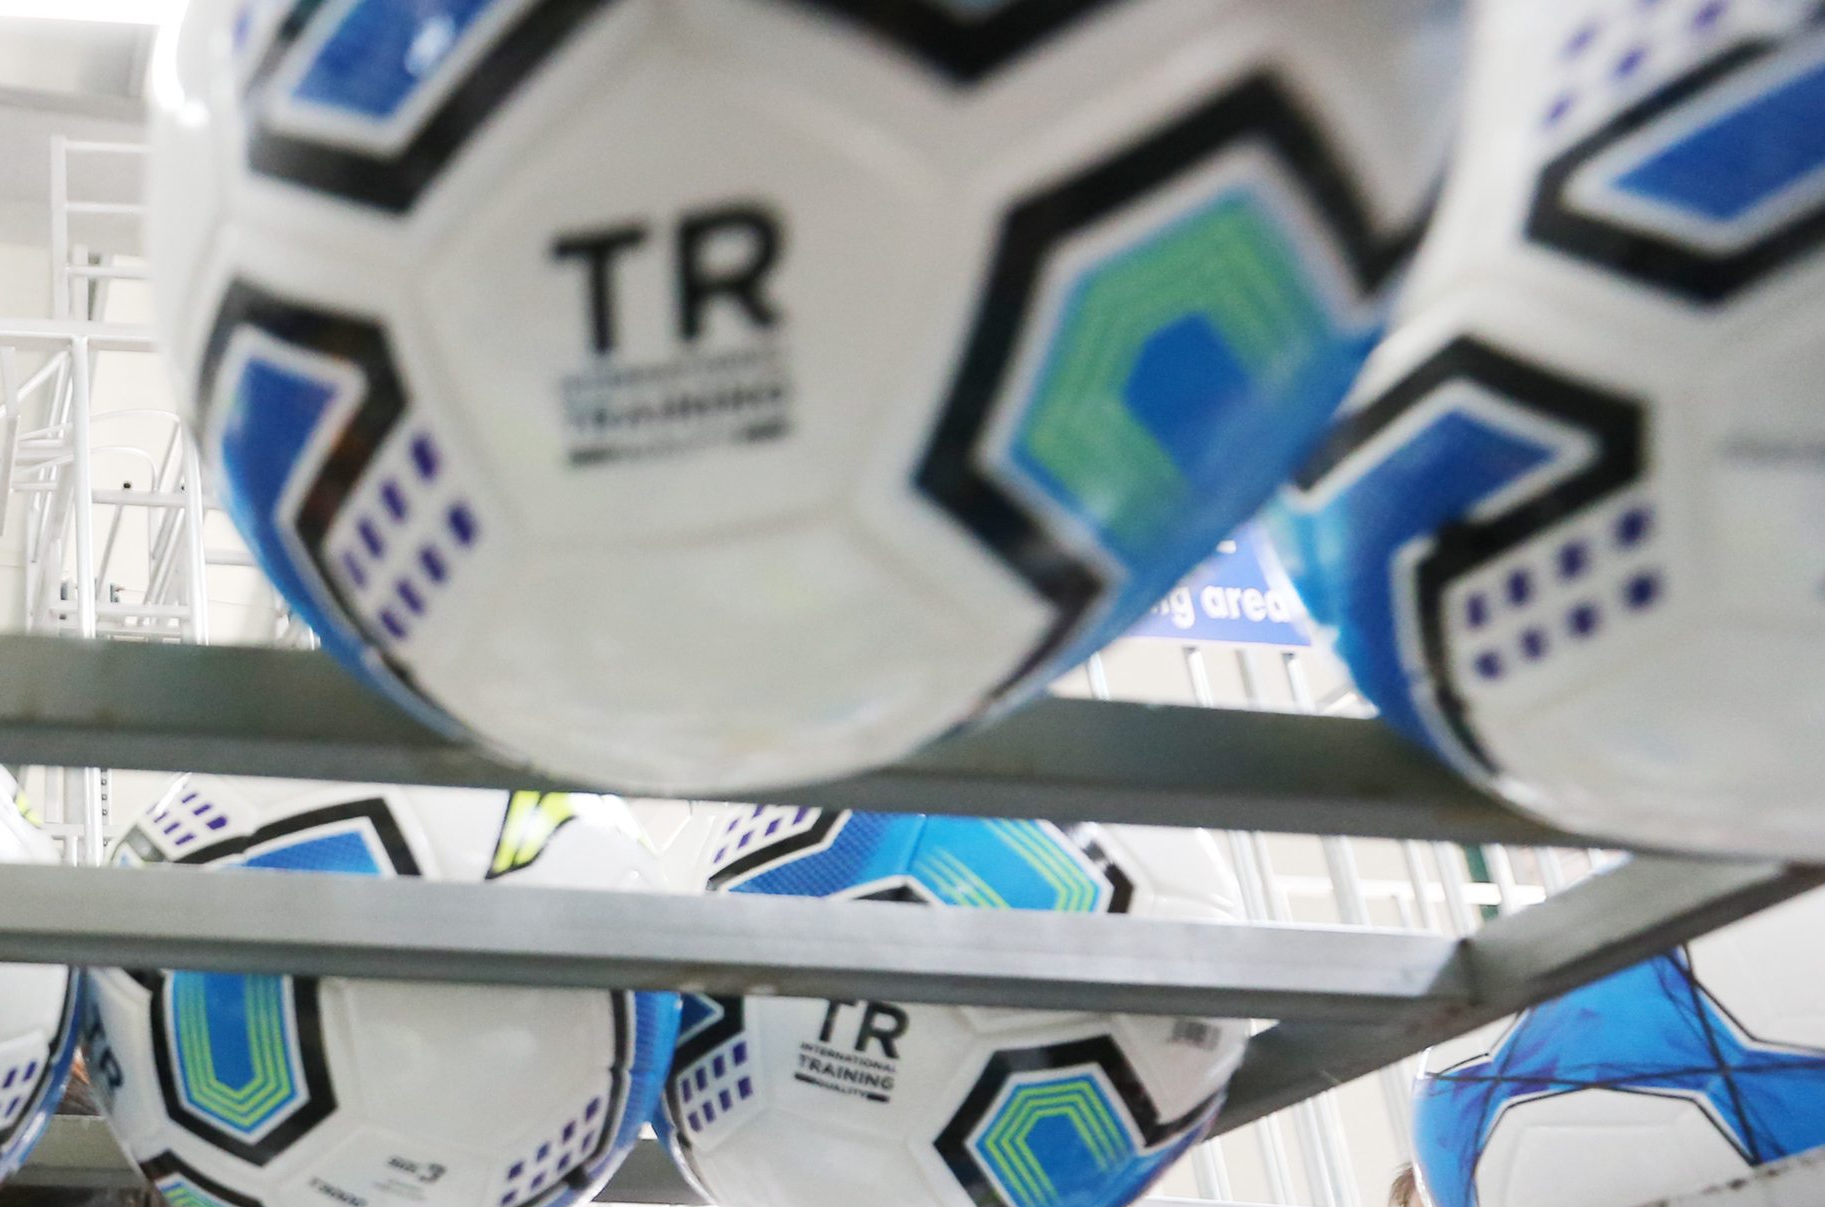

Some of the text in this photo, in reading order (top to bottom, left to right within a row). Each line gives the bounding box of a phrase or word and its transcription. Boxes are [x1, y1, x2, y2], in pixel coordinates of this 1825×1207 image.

[550, 202, 786, 353] TR
[818, 999, 910, 1059] TR
[798, 1053, 895, 1090] TRAINING
[800, 1042, 896, 1073] INTERNATIONAL
